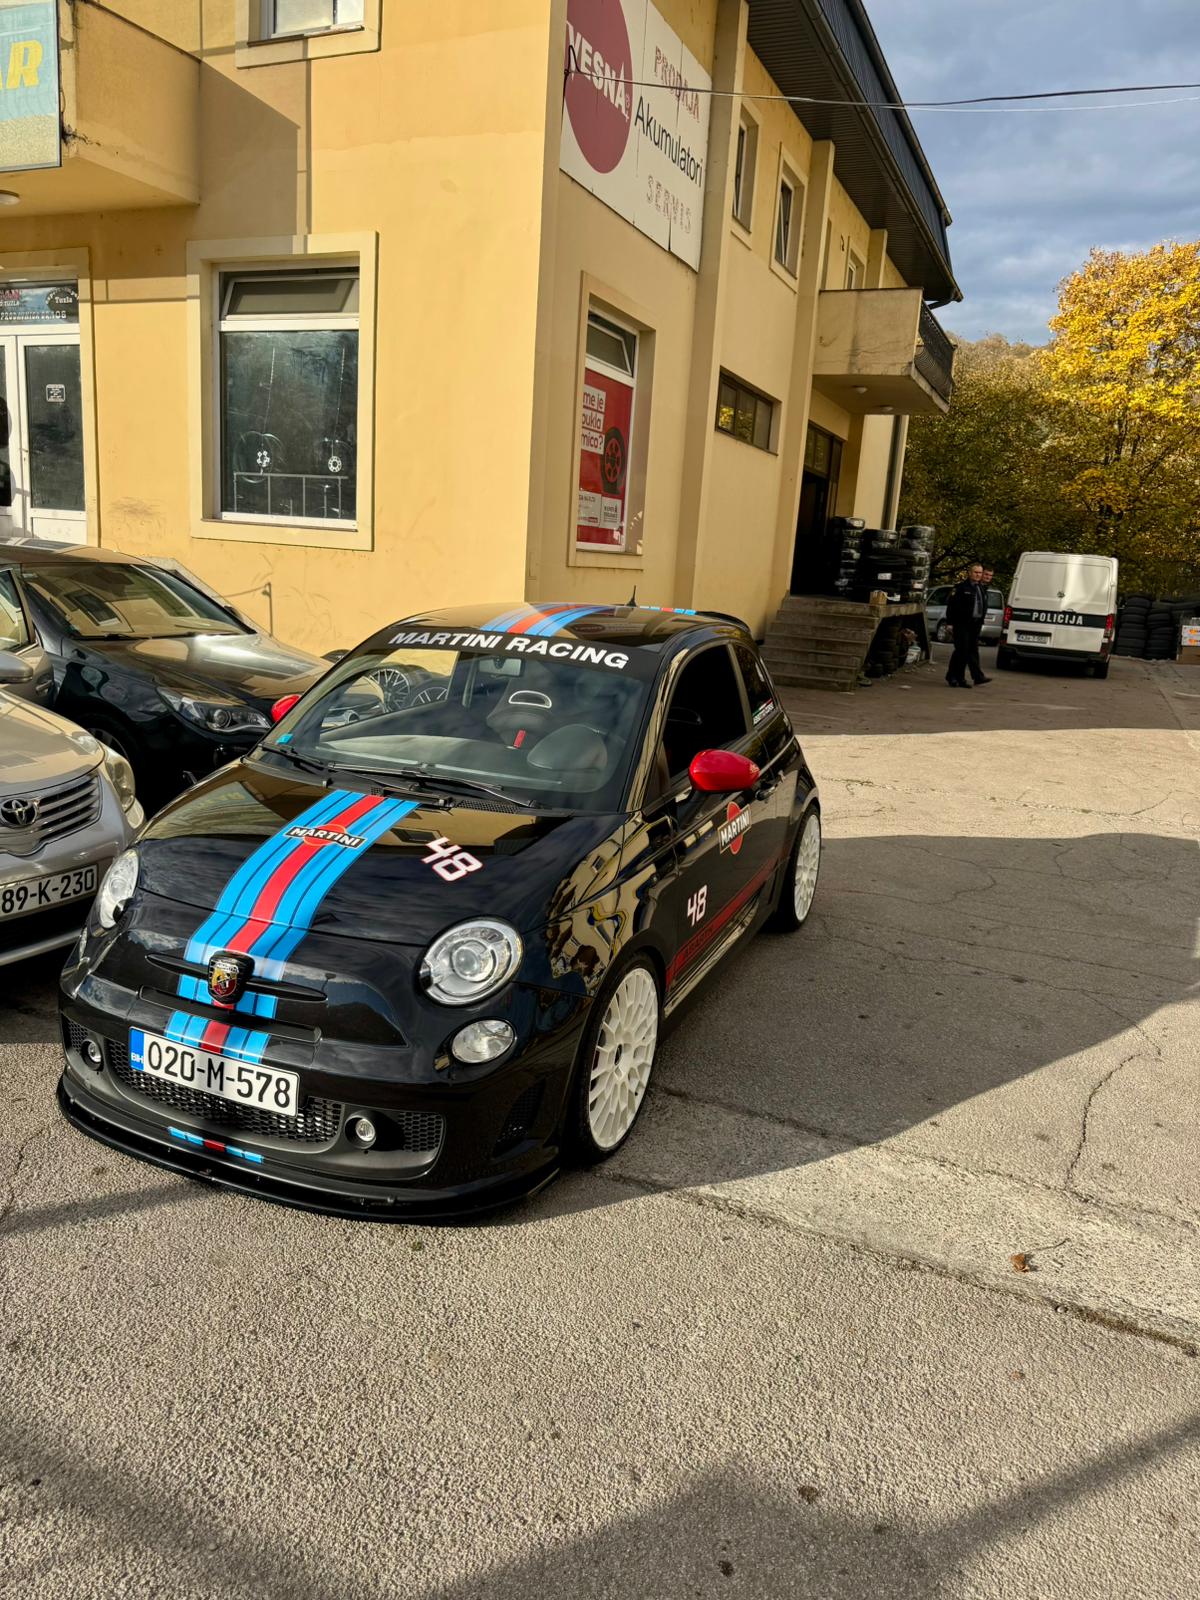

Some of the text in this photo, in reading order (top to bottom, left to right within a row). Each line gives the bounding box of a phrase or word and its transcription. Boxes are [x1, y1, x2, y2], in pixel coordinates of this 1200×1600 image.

[0, 39, 43, 90] R
[566, 20, 627, 116] VESNA
[654, 45, 700, 123] PRODAJA
[634, 95, 703, 187] Akumulatori
[646, 174, 692, 234] SERVIS
[1032, 612, 1083, 625] POLICIJA
[388, 632, 630, 670] MARTINI RACING
[291, 826, 361, 847] MARTINI
[719, 810, 751, 847] MARTINI
[420, 836, 484, 882] 48
[687, 884, 708, 927] 48
[147, 1040, 292, 1109] 020-M-578
